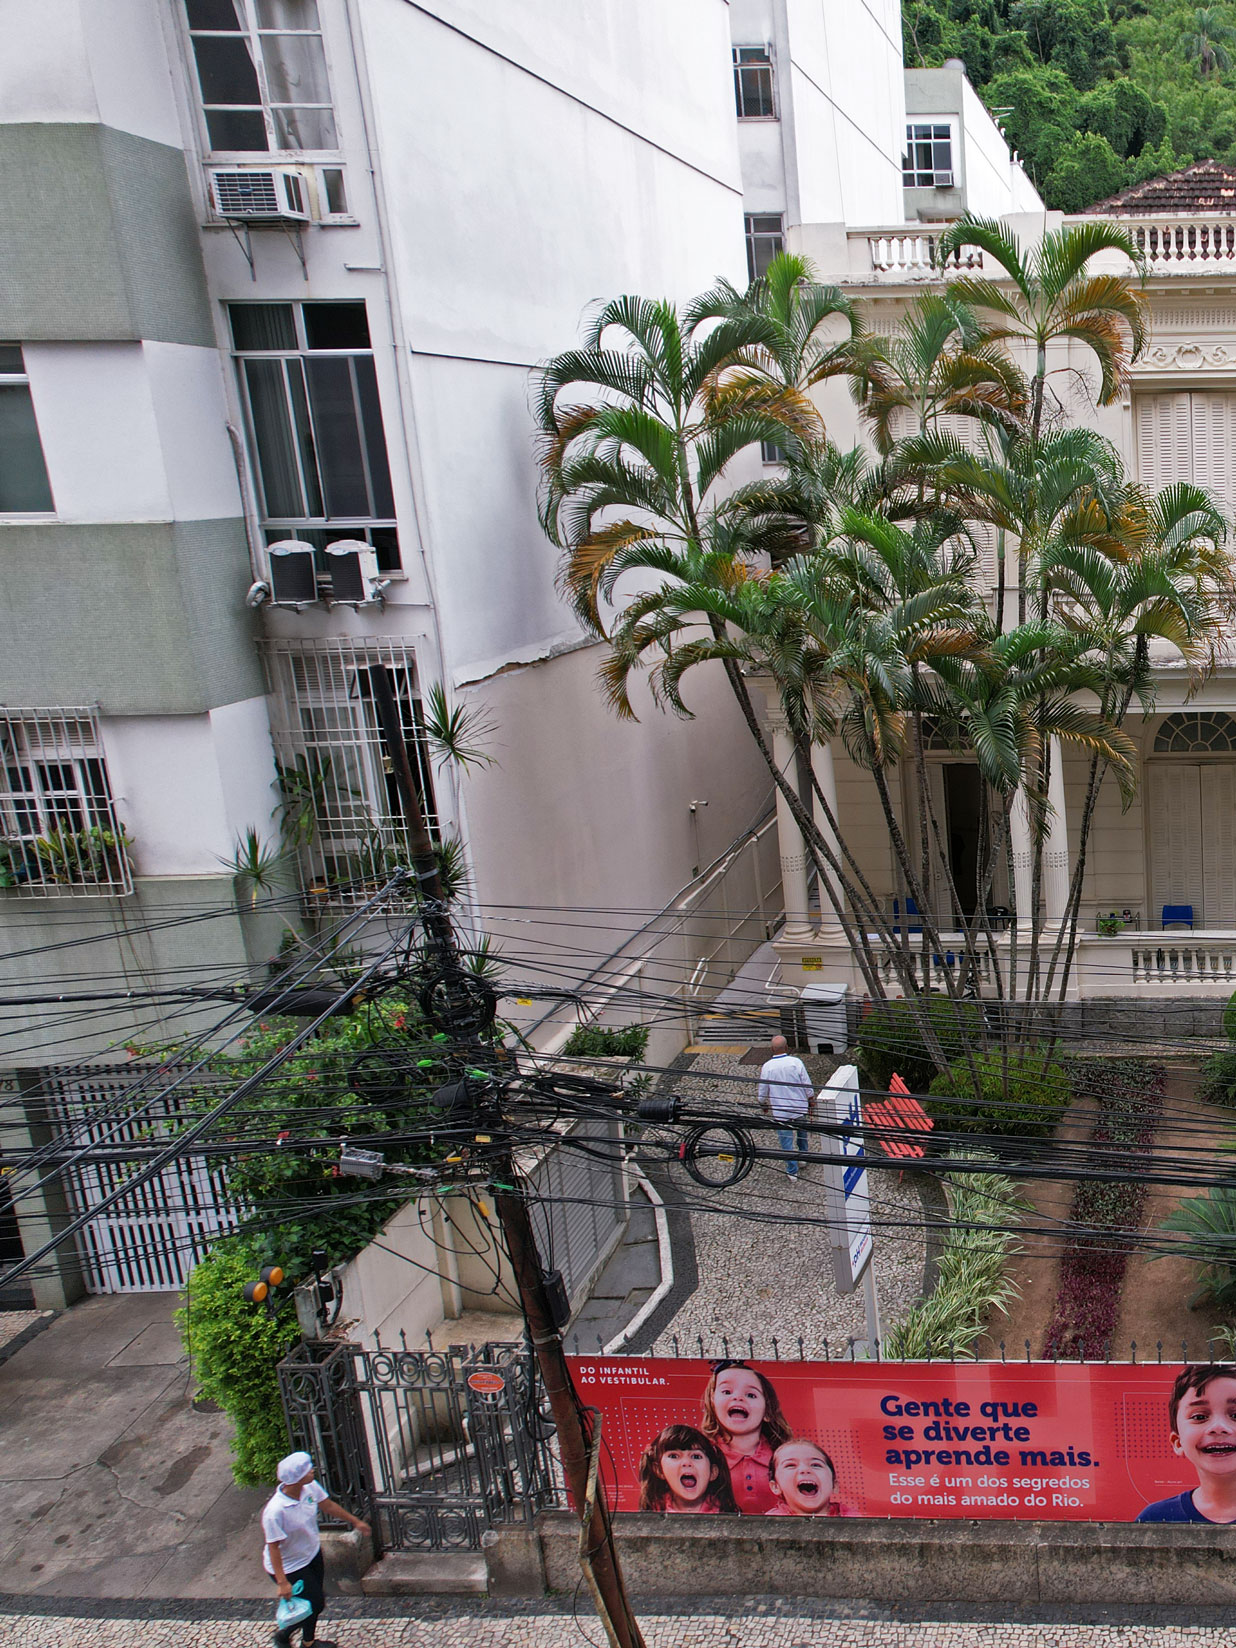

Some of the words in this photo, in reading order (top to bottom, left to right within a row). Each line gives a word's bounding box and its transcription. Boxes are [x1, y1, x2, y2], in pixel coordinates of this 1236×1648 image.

[580, 1366, 596, 1375] DO
[599, 1367, 650, 1376] INFANTIL
[581, 1376, 596, 1384] AO
[599, 1376, 670, 1386] VESTIBULAR.
[880, 1395, 970, 1418] Gente
[980, 1402, 1038, 1422] que
[882, 1424, 914, 1441] se
[924, 1421, 1030, 1442] diverte
[886, 1446, 1010, 1470] aprende
[1019, 1446, 1100, 1467] mais.
[888, 1473, 924, 1487] Esse
[930, 1474, 940, 1487] é
[945, 1477, 972, 1488] um
[977, 1474, 1008, 1488] dos
[1013, 1475, 1090, 1492] segredos
[890, 1492, 912, 1504] do
[918, 1492, 956, 1506] mais
[961, 1492, 1019, 1506] amado
[1024, 1493, 1047, 1506] do
[1052, 1493, 1084, 1507] Rio.
